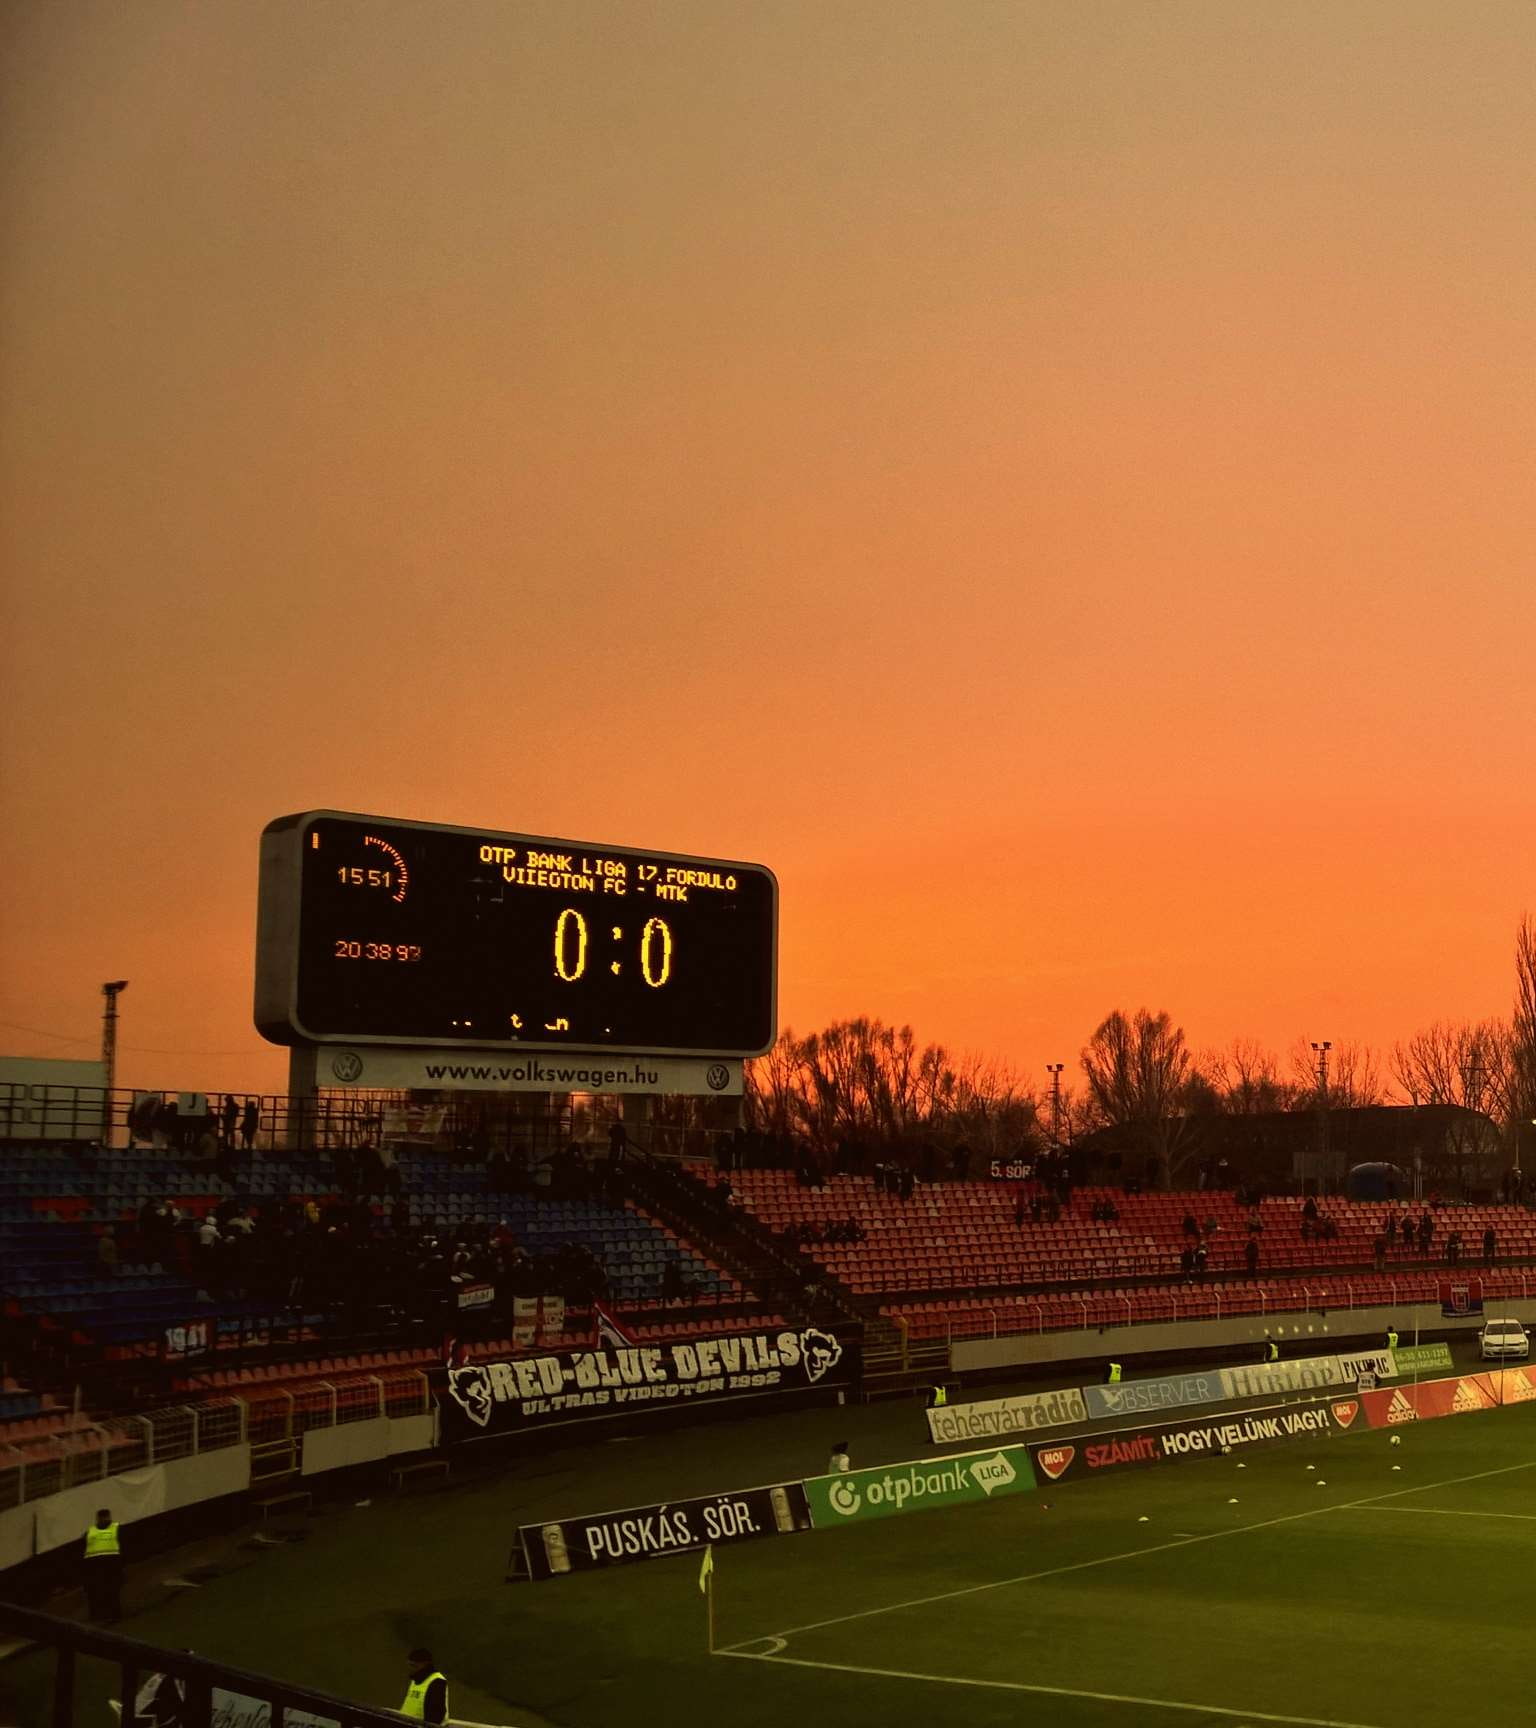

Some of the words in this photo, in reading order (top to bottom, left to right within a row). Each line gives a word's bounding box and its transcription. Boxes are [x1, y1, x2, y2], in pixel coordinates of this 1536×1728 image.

[480, 846, 515, 864] OTP
[527, 851, 572, 871] BANK
[582, 858, 626, 878] LIGA
[604, 878, 626, 895] FC
[656, 884, 687, 902] MTK
[425, 1061, 659, 1087] www.volkswagen.hu
[487, 1348, 667, 1402] RED-BLUE
[672, 1332, 801, 1380] DEVILS
[521, 1391, 611, 1416] ULTRAS
[614, 1376, 724, 1403] VIDEOTON
[729, 1369, 782, 1390] 1992
[1453, 1399, 1482, 1412] adidas
[1085, 1434, 1161, 1468] SZÁMÍT,
[1160, 1429, 1215, 1456] HOGY
[1215, 1417, 1284, 1449] VELÜNK
[1281, 1409, 1331, 1436] VAGY!
[980, 1465, 1009, 1481] LIGA
[1043, 1452, 1064, 1466] MOL
[585, 1505, 699, 1560] PUSKÁS.
[703, 1497, 761, 1539] SÖR.
